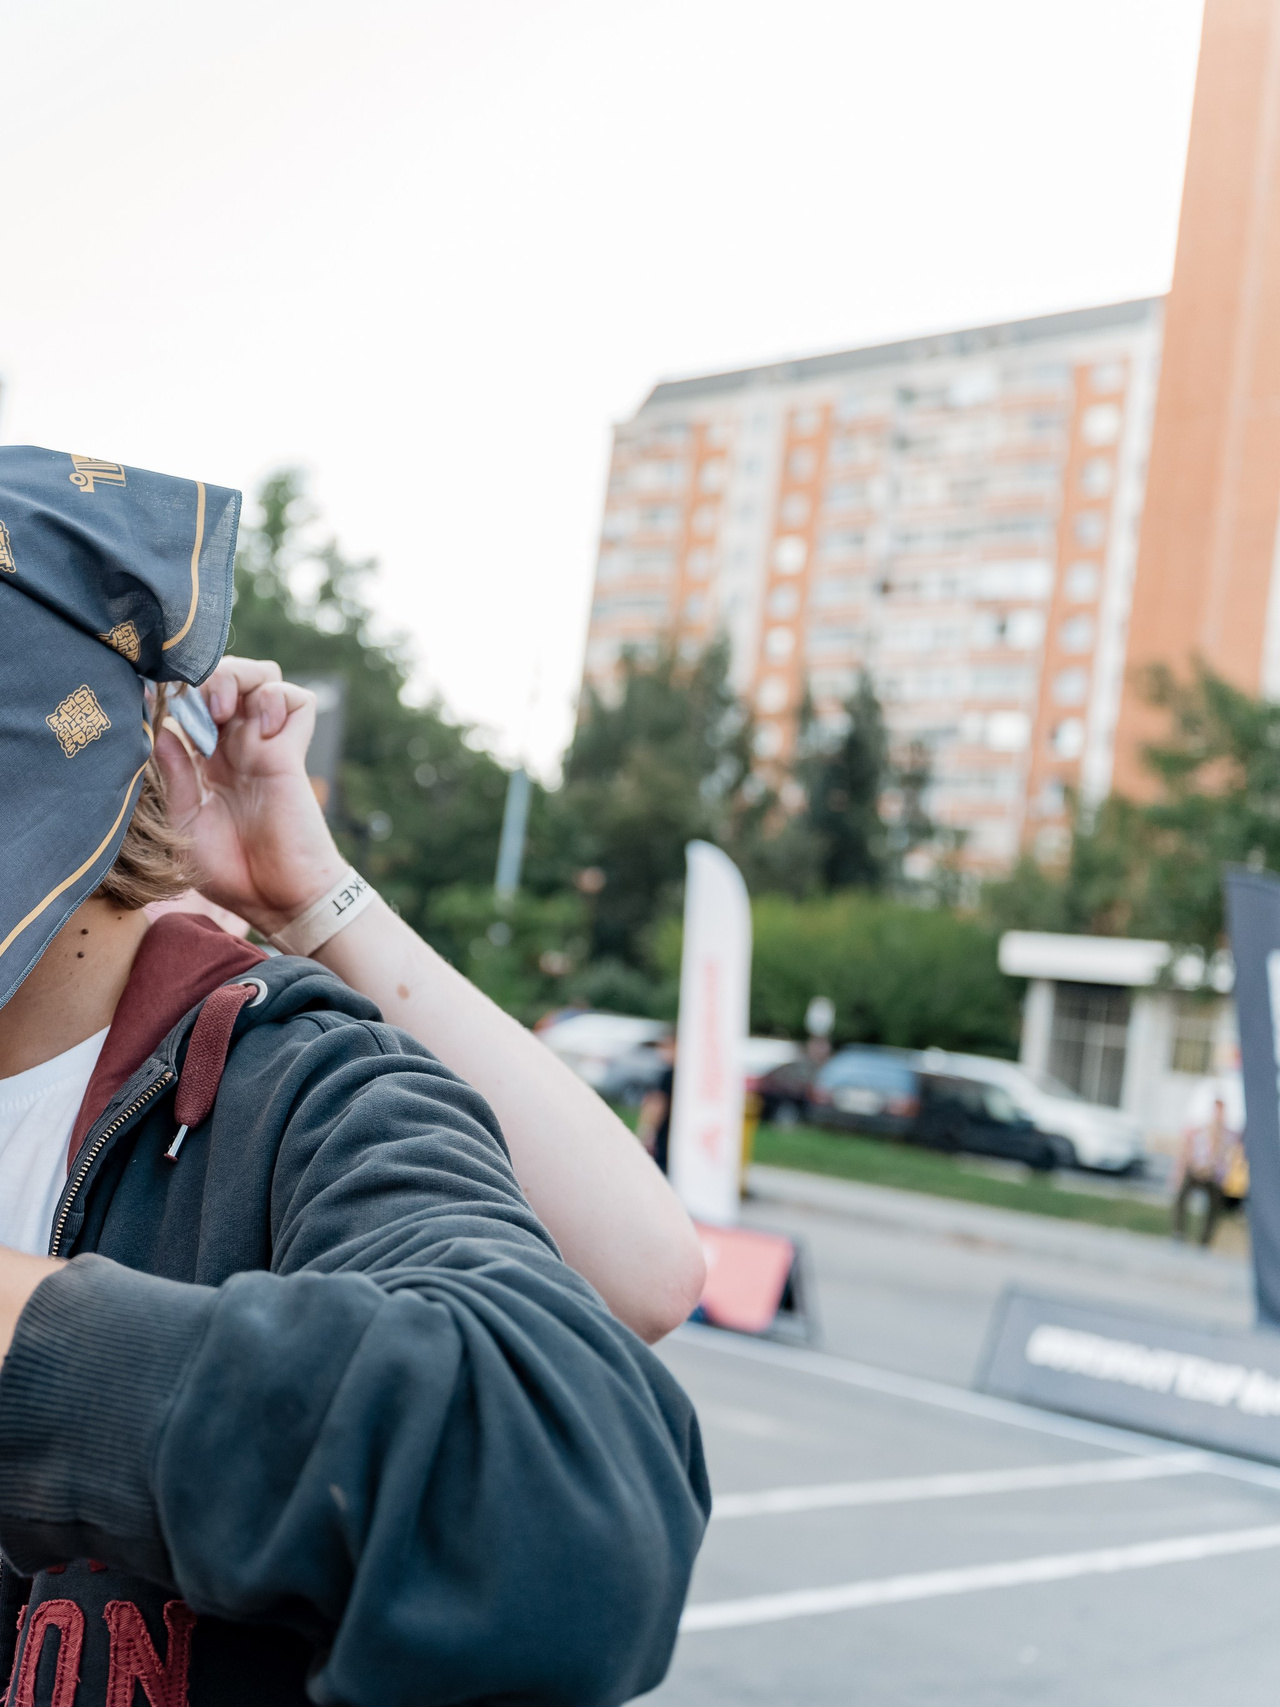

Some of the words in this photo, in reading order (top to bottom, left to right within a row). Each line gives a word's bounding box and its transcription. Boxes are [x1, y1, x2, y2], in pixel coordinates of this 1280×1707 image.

[58, 707, 87, 745] ТУР
[61, 697, 98, 741] БАСКЕТ
[74, 689, 108, 730] СТРИТ
[49, 715, 77, 754] МОСКВА
